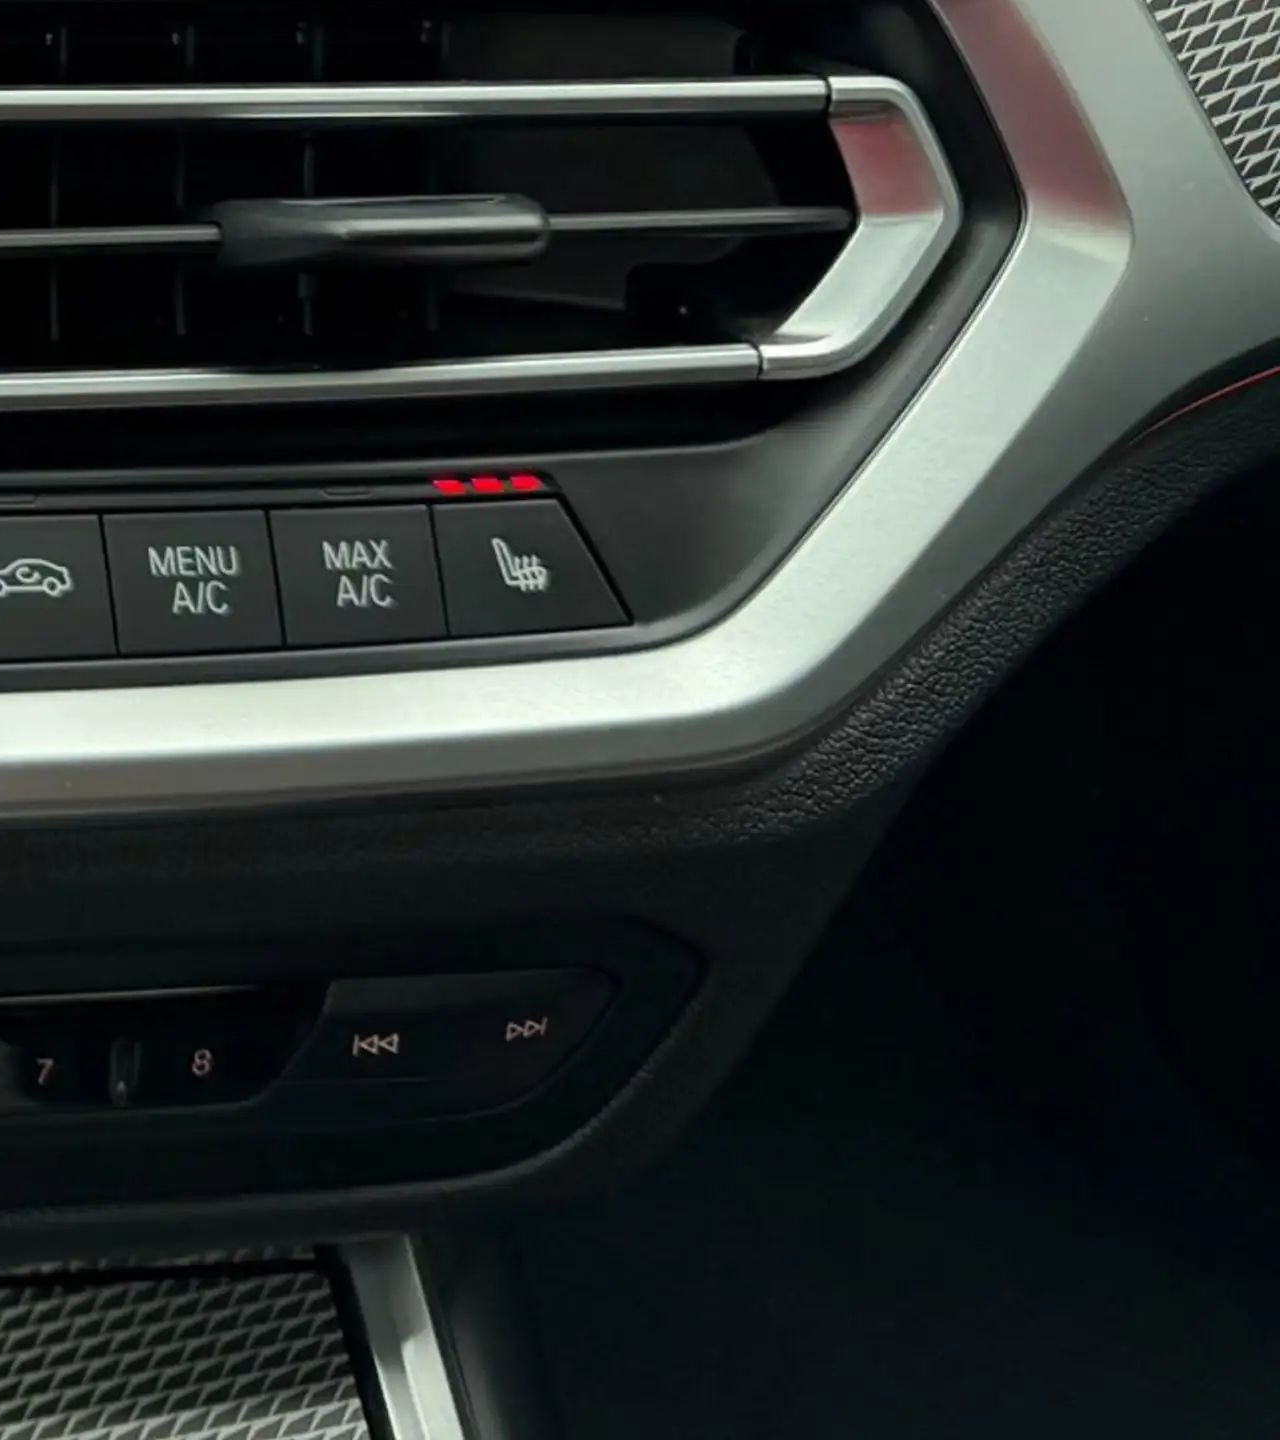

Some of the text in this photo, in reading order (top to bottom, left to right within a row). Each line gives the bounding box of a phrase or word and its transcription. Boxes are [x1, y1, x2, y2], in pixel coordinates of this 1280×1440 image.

[148, 546, 238, 576] MENU
[322, 540, 392, 569] MAX
[172, 580, 229, 615] A/C
[337, 573, 392, 607] A/C
[37, 1058, 54, 1085] 7
[191, 1049, 212, 1076] 8
